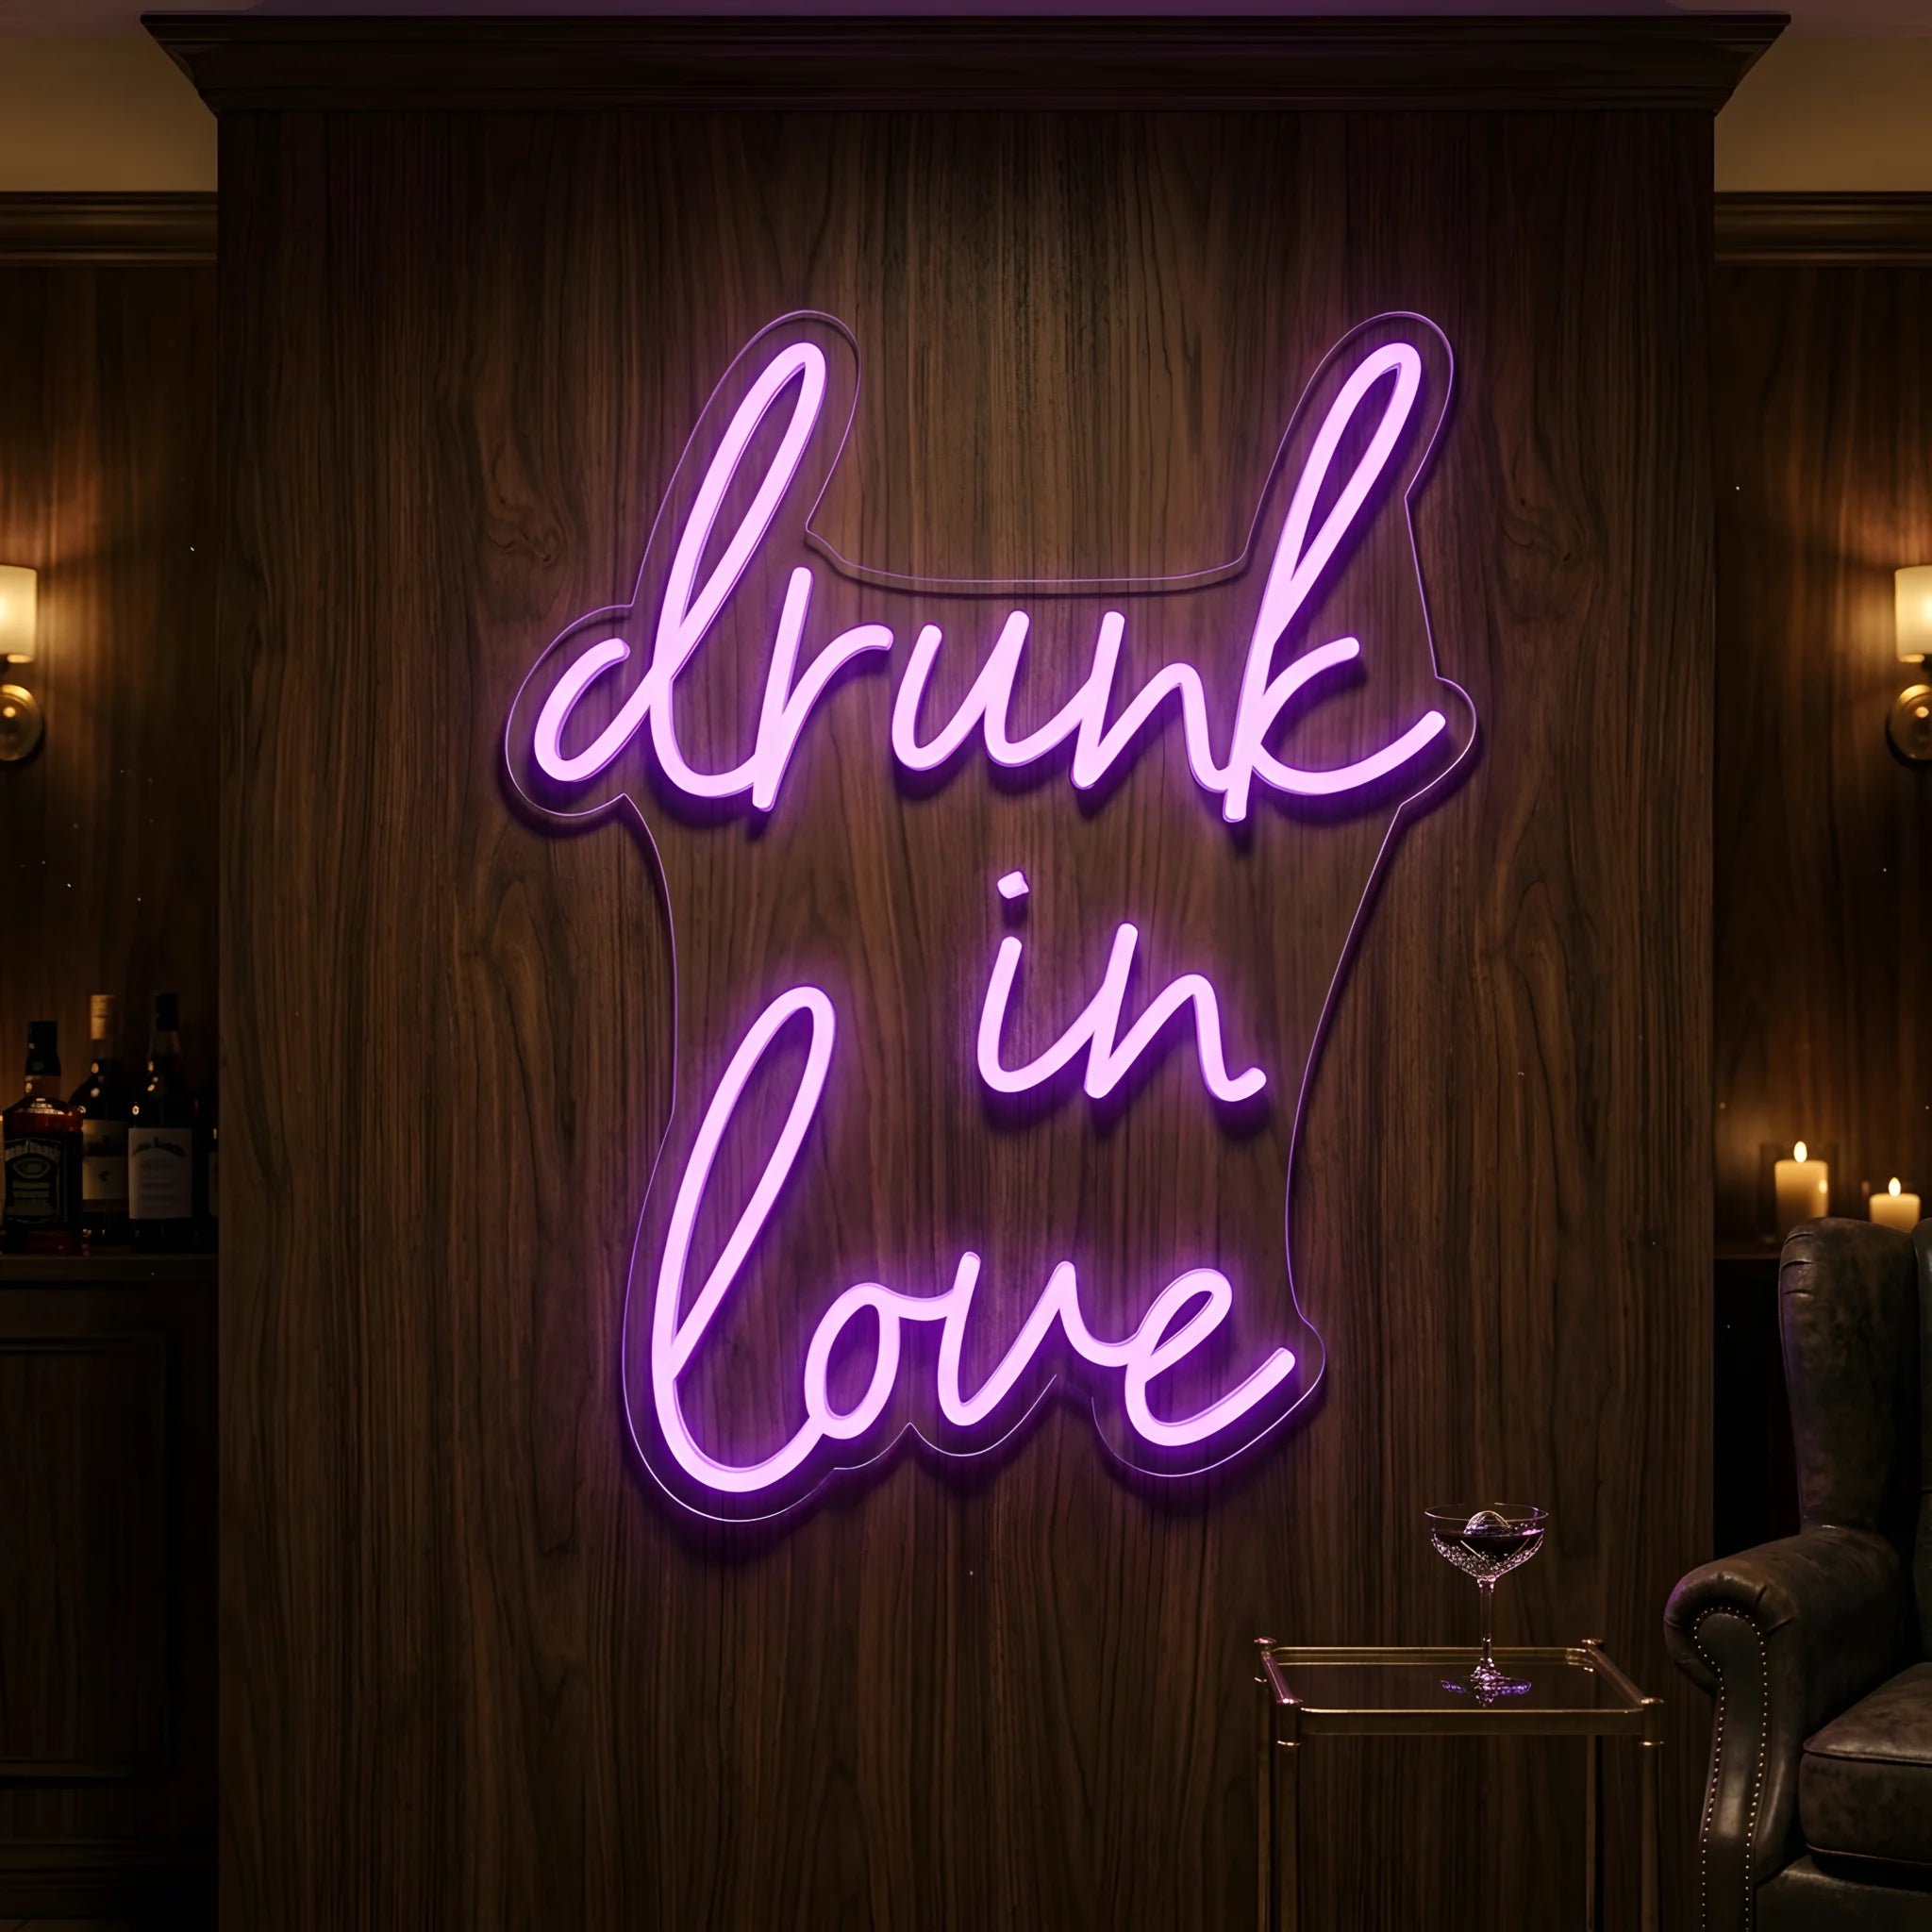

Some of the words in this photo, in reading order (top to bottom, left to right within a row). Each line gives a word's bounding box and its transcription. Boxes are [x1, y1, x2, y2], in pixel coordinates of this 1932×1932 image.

[533, 341, 1447, 824] drunk
[975, 870, 1268, 1103] in
[650, 985, 1297, 1493] love
